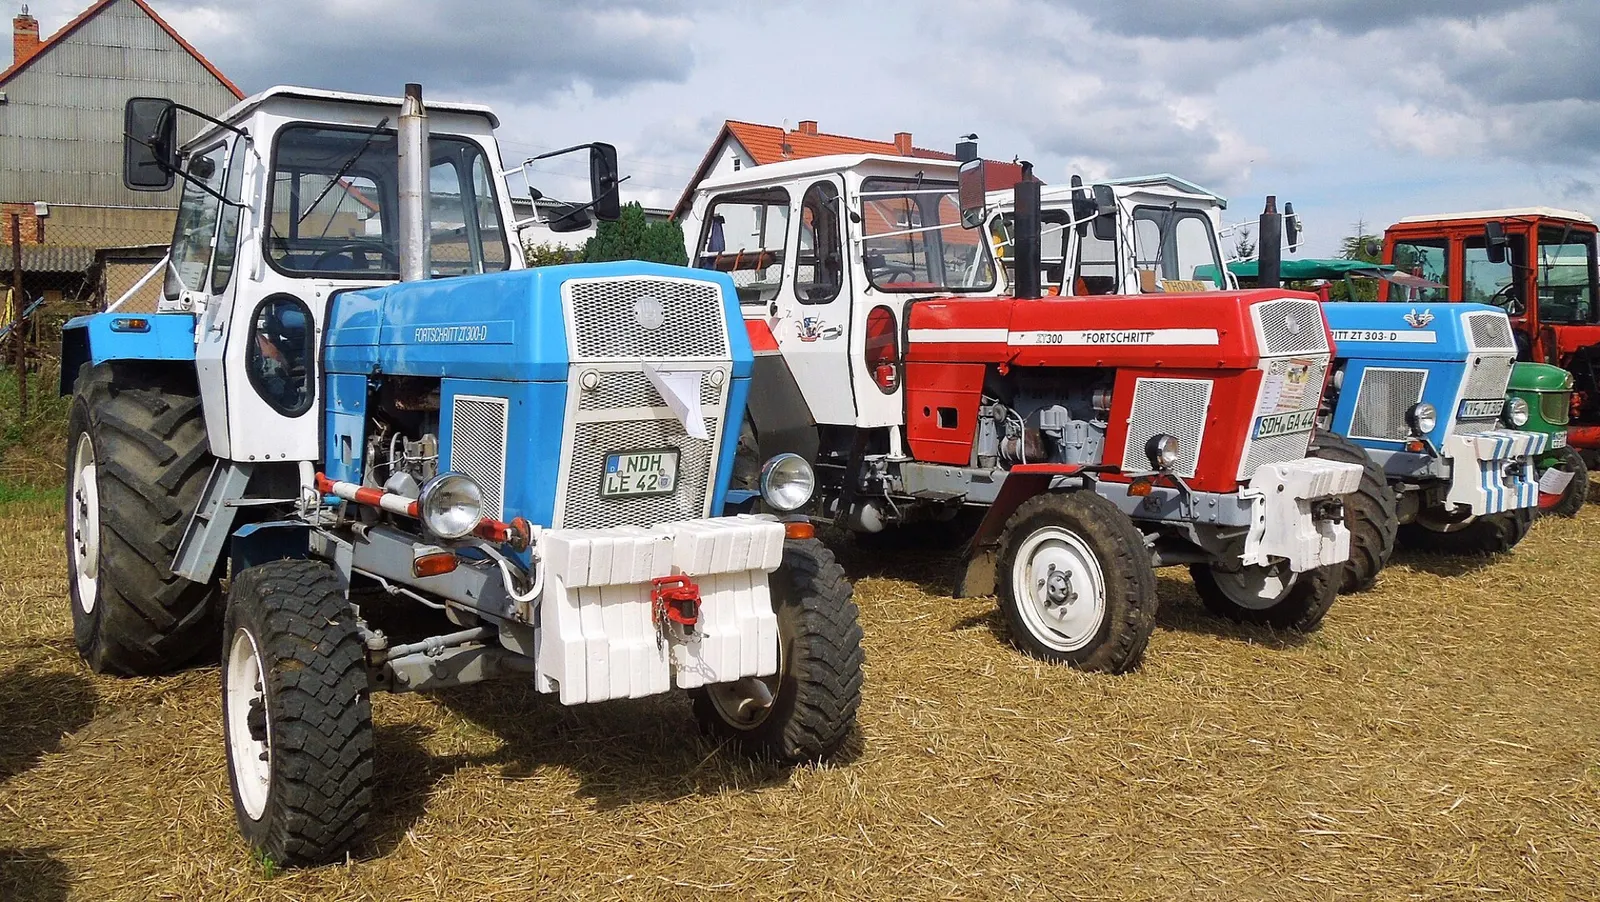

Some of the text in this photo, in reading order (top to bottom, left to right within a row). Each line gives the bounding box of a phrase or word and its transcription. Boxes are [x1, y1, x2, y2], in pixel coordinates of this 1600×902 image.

[1164, 281, 1205, 292] THOMAS
[414, 327, 459, 342] FORTSCHRITT
[1350, 331, 1363, 340] ZT
[1260, 411, 1316, 435] SDH GA 44
[626, 455, 662, 473] NDH
[607, 474, 658, 494] LE 42
